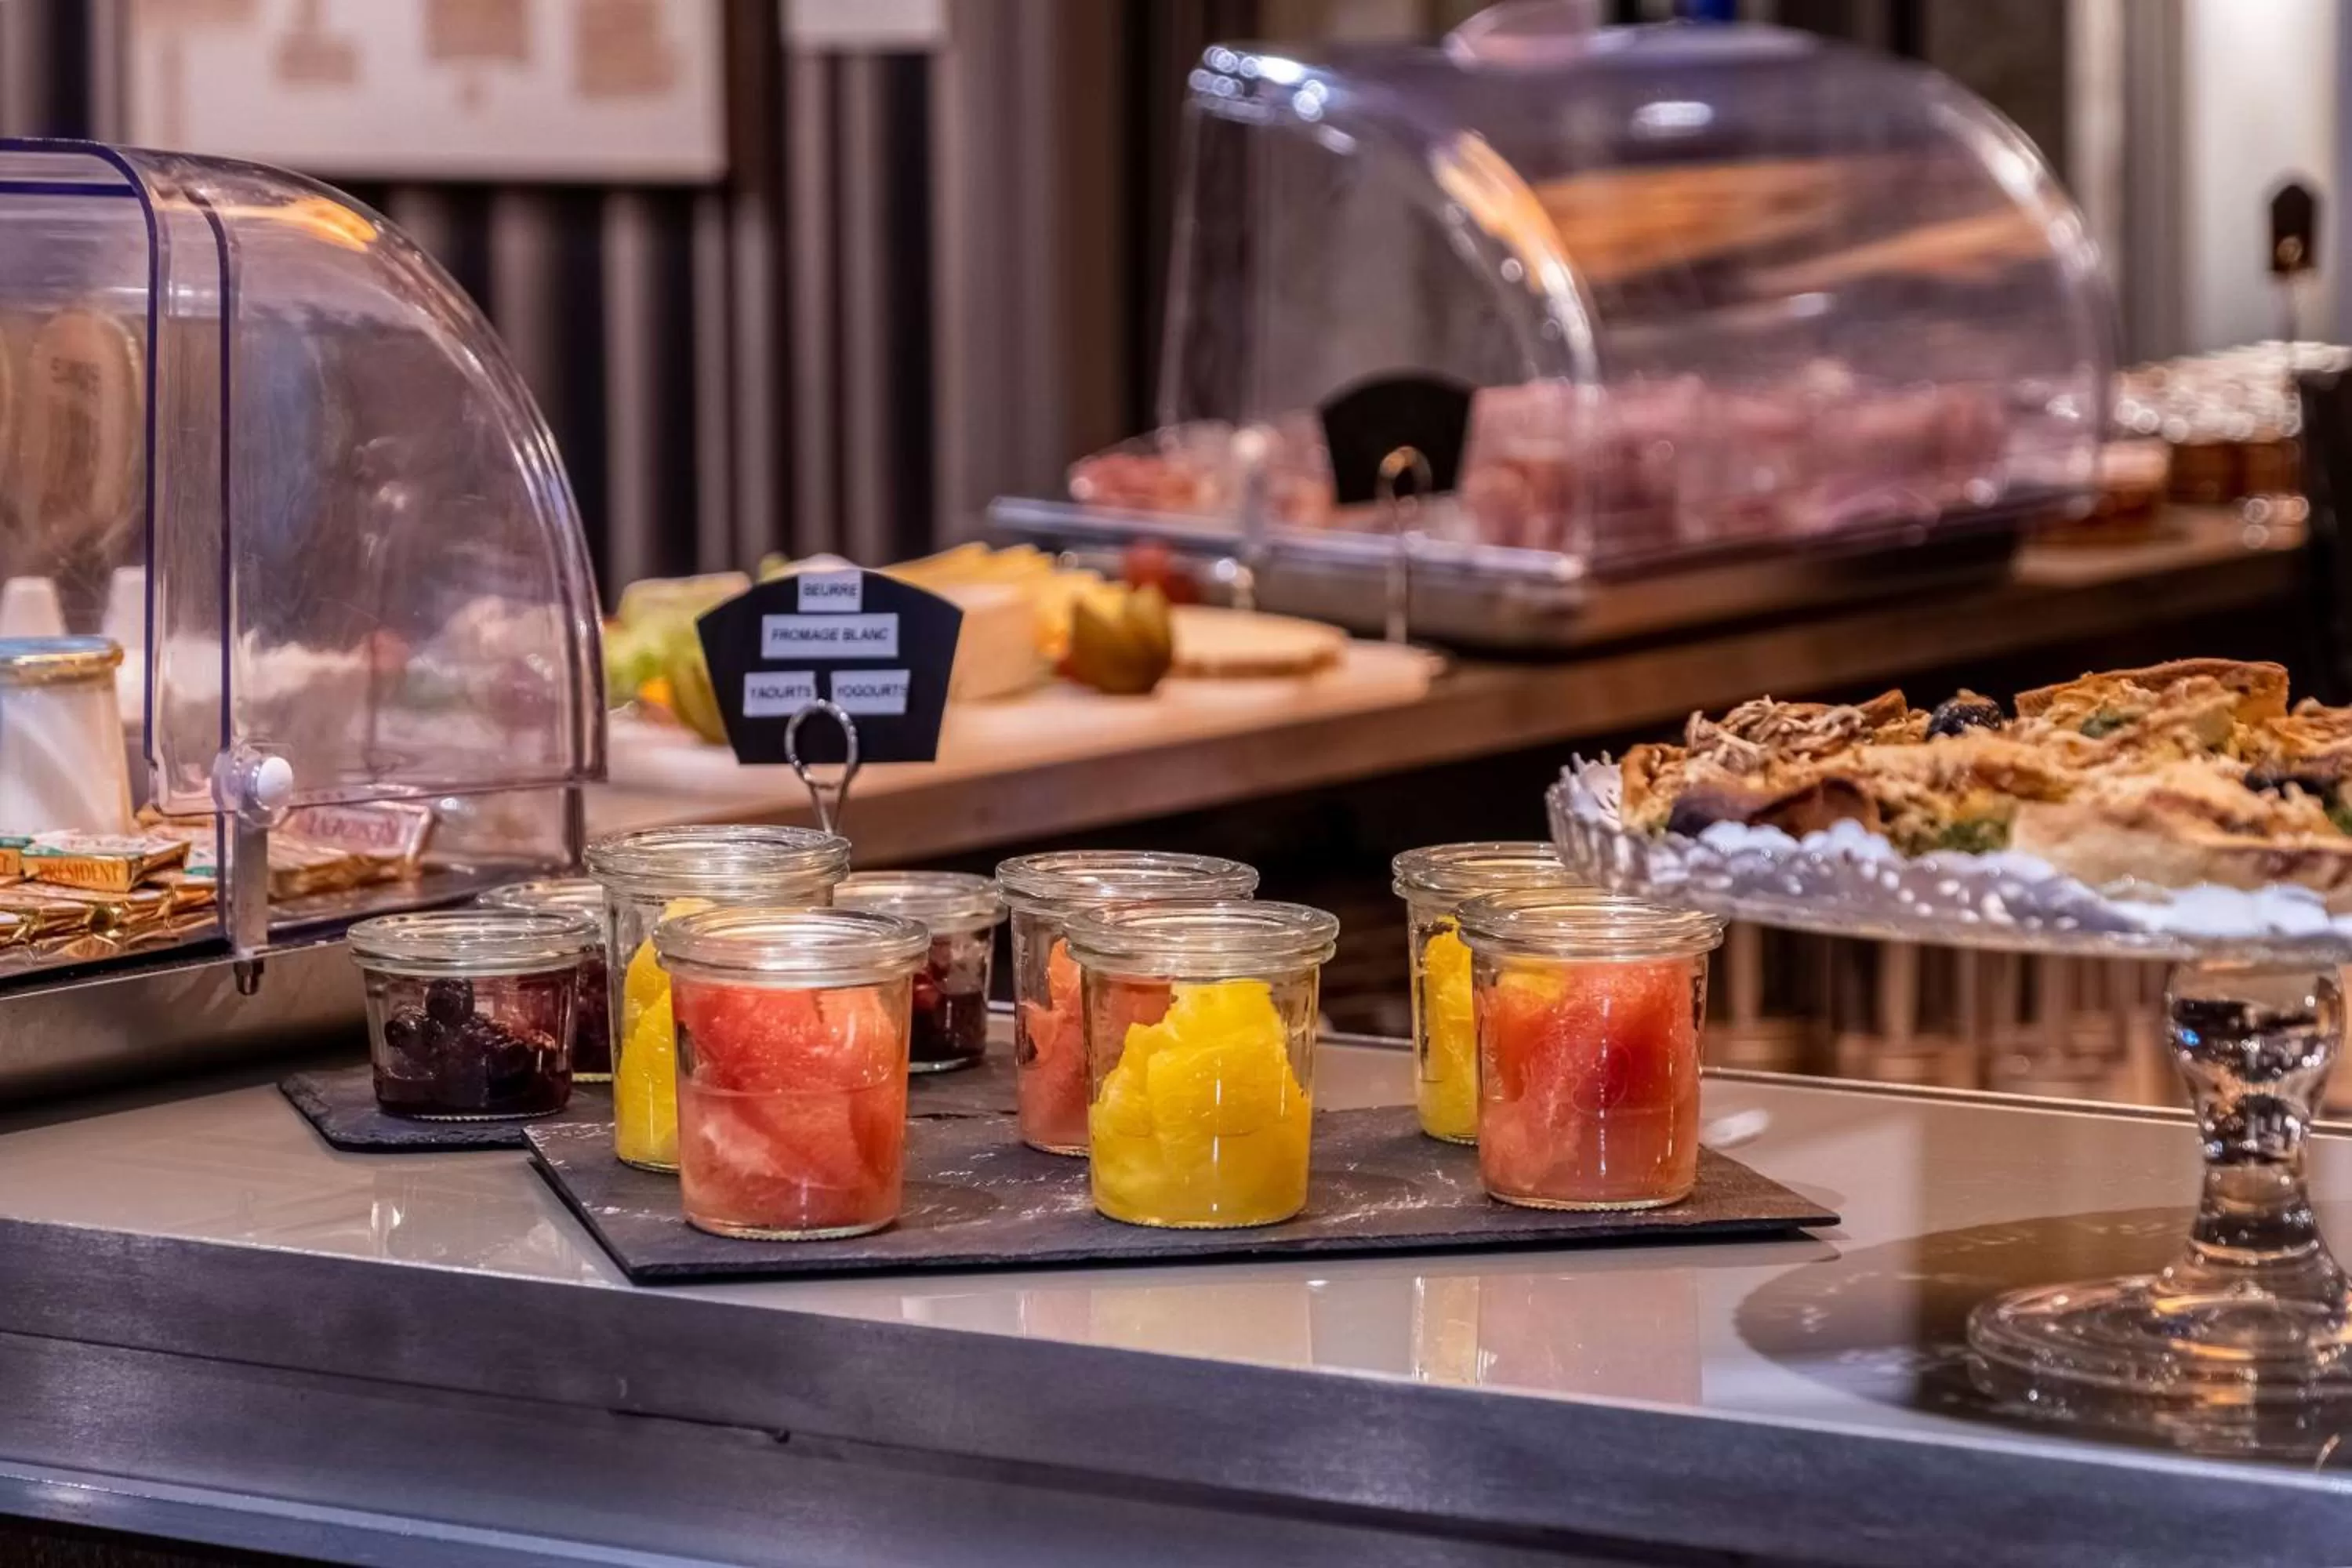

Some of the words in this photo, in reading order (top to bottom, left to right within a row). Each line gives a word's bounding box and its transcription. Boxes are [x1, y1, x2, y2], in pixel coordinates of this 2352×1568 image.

[804, 583, 858, 597] BEURRE
[771, 627, 838, 641] FROMAGE
[842, 626, 889, 640] BLANC
[751, 685, 812, 699] YAOURTS
